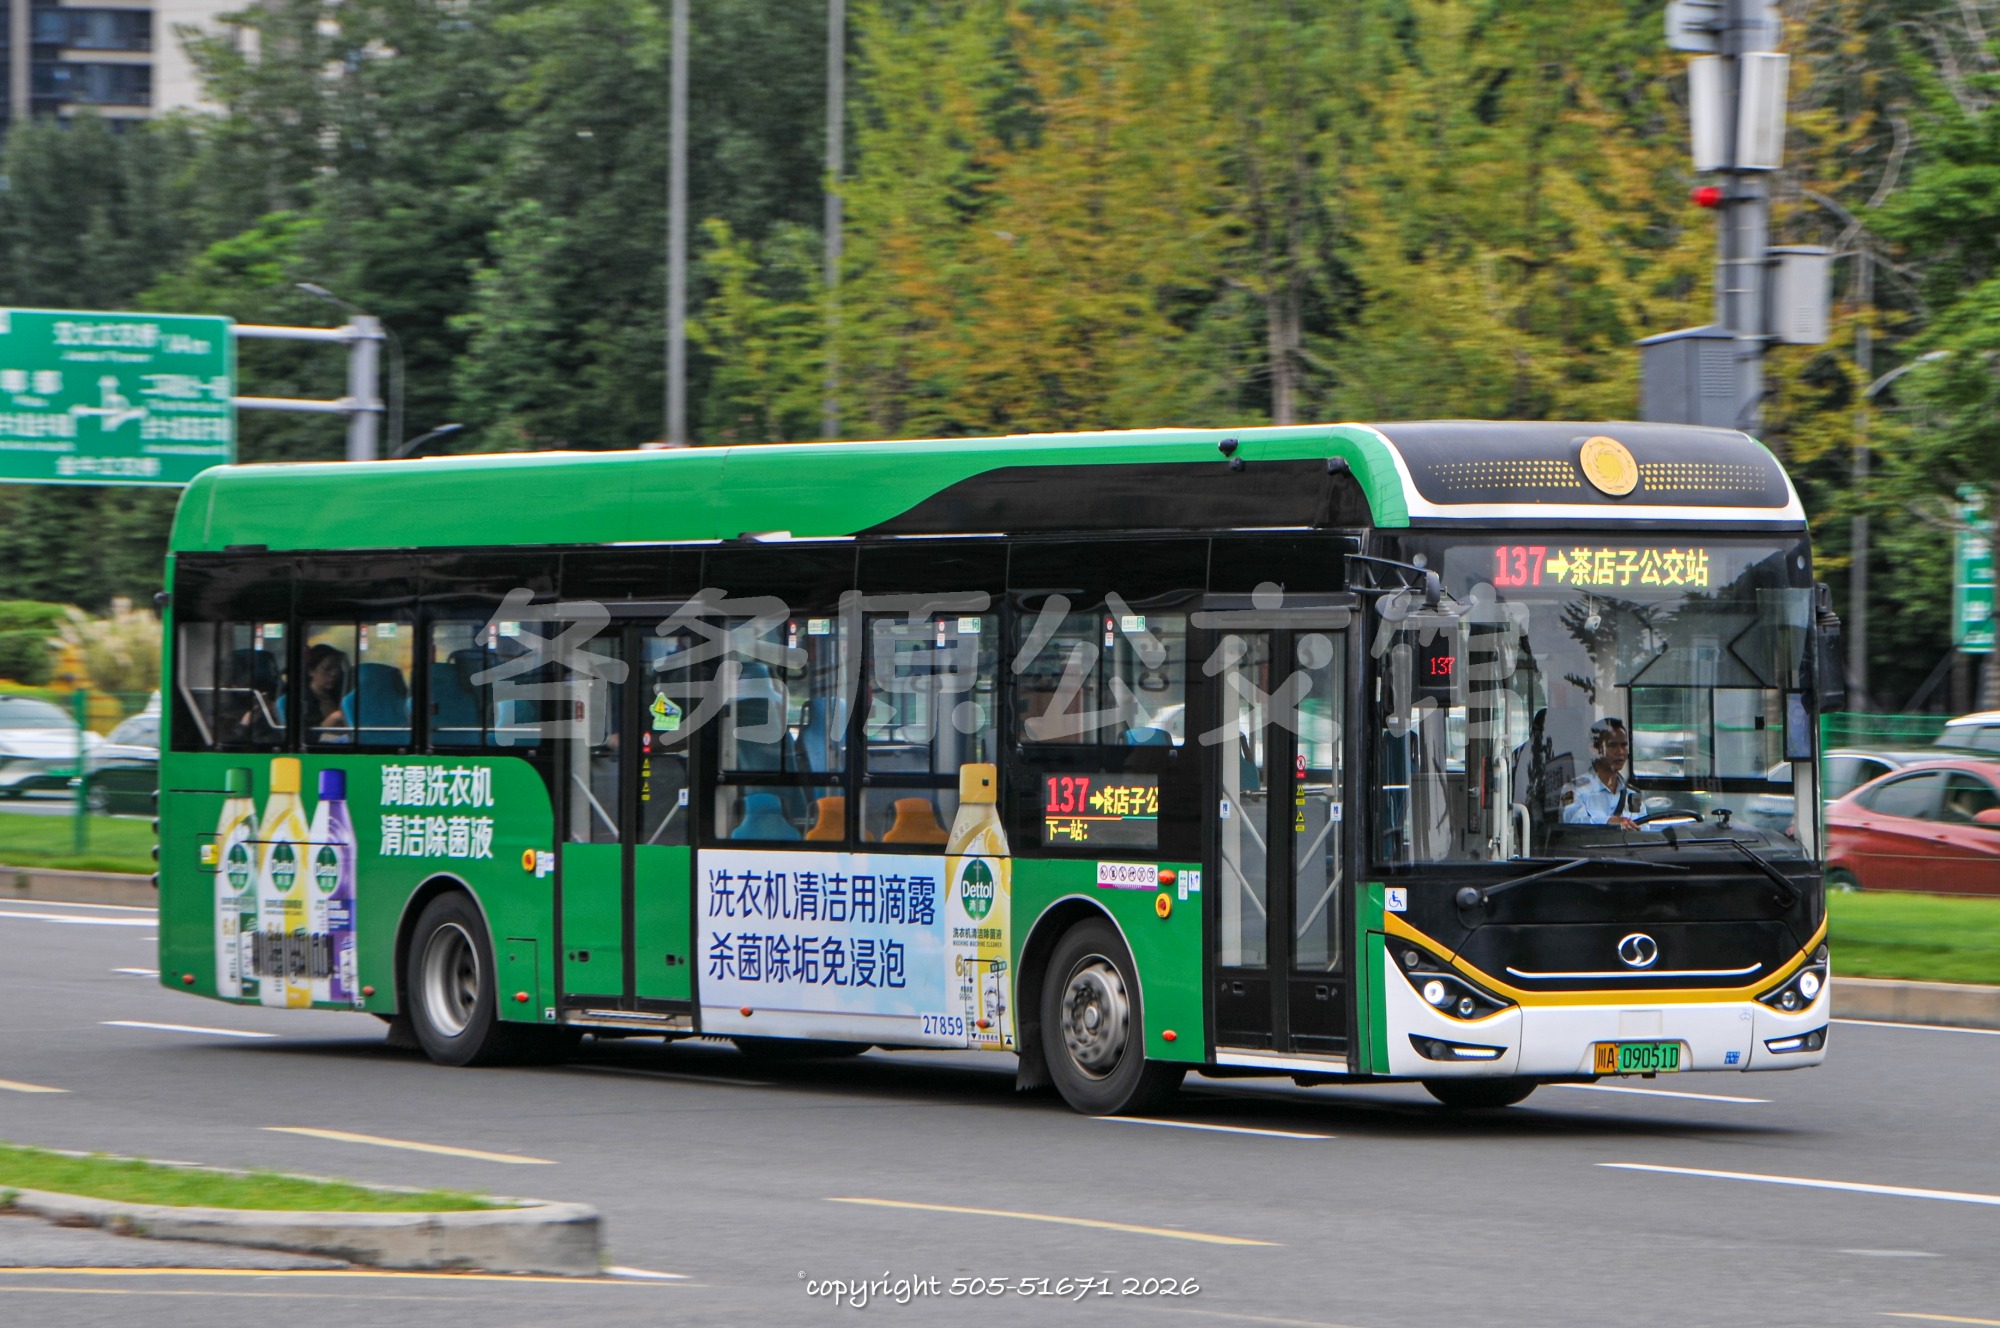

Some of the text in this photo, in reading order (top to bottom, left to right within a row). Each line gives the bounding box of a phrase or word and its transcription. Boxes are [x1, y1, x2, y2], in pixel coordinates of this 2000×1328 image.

[1494, 545, 1710, 587] 137 茶店子公交站
[1430, 656, 1456, 675] 137
[380, 764, 495, 808] 滴露洗衣机
[1046, 776, 1091, 813] 137
[379, 814, 495, 859] 清洁除菌液
[708, 868, 936, 927] 洗衣机清洁用滴露
[962, 880, 993, 899] Dettol
[968, 899, 987, 913] 滴露
[952, 927, 1003, 940] 洗衣机清洁除菌液
[708, 931, 907, 989] 杀菌除垢免浸泡
[922, 1014, 964, 1037] 27859
[1622, 1047, 1679, 1069] 09051D
